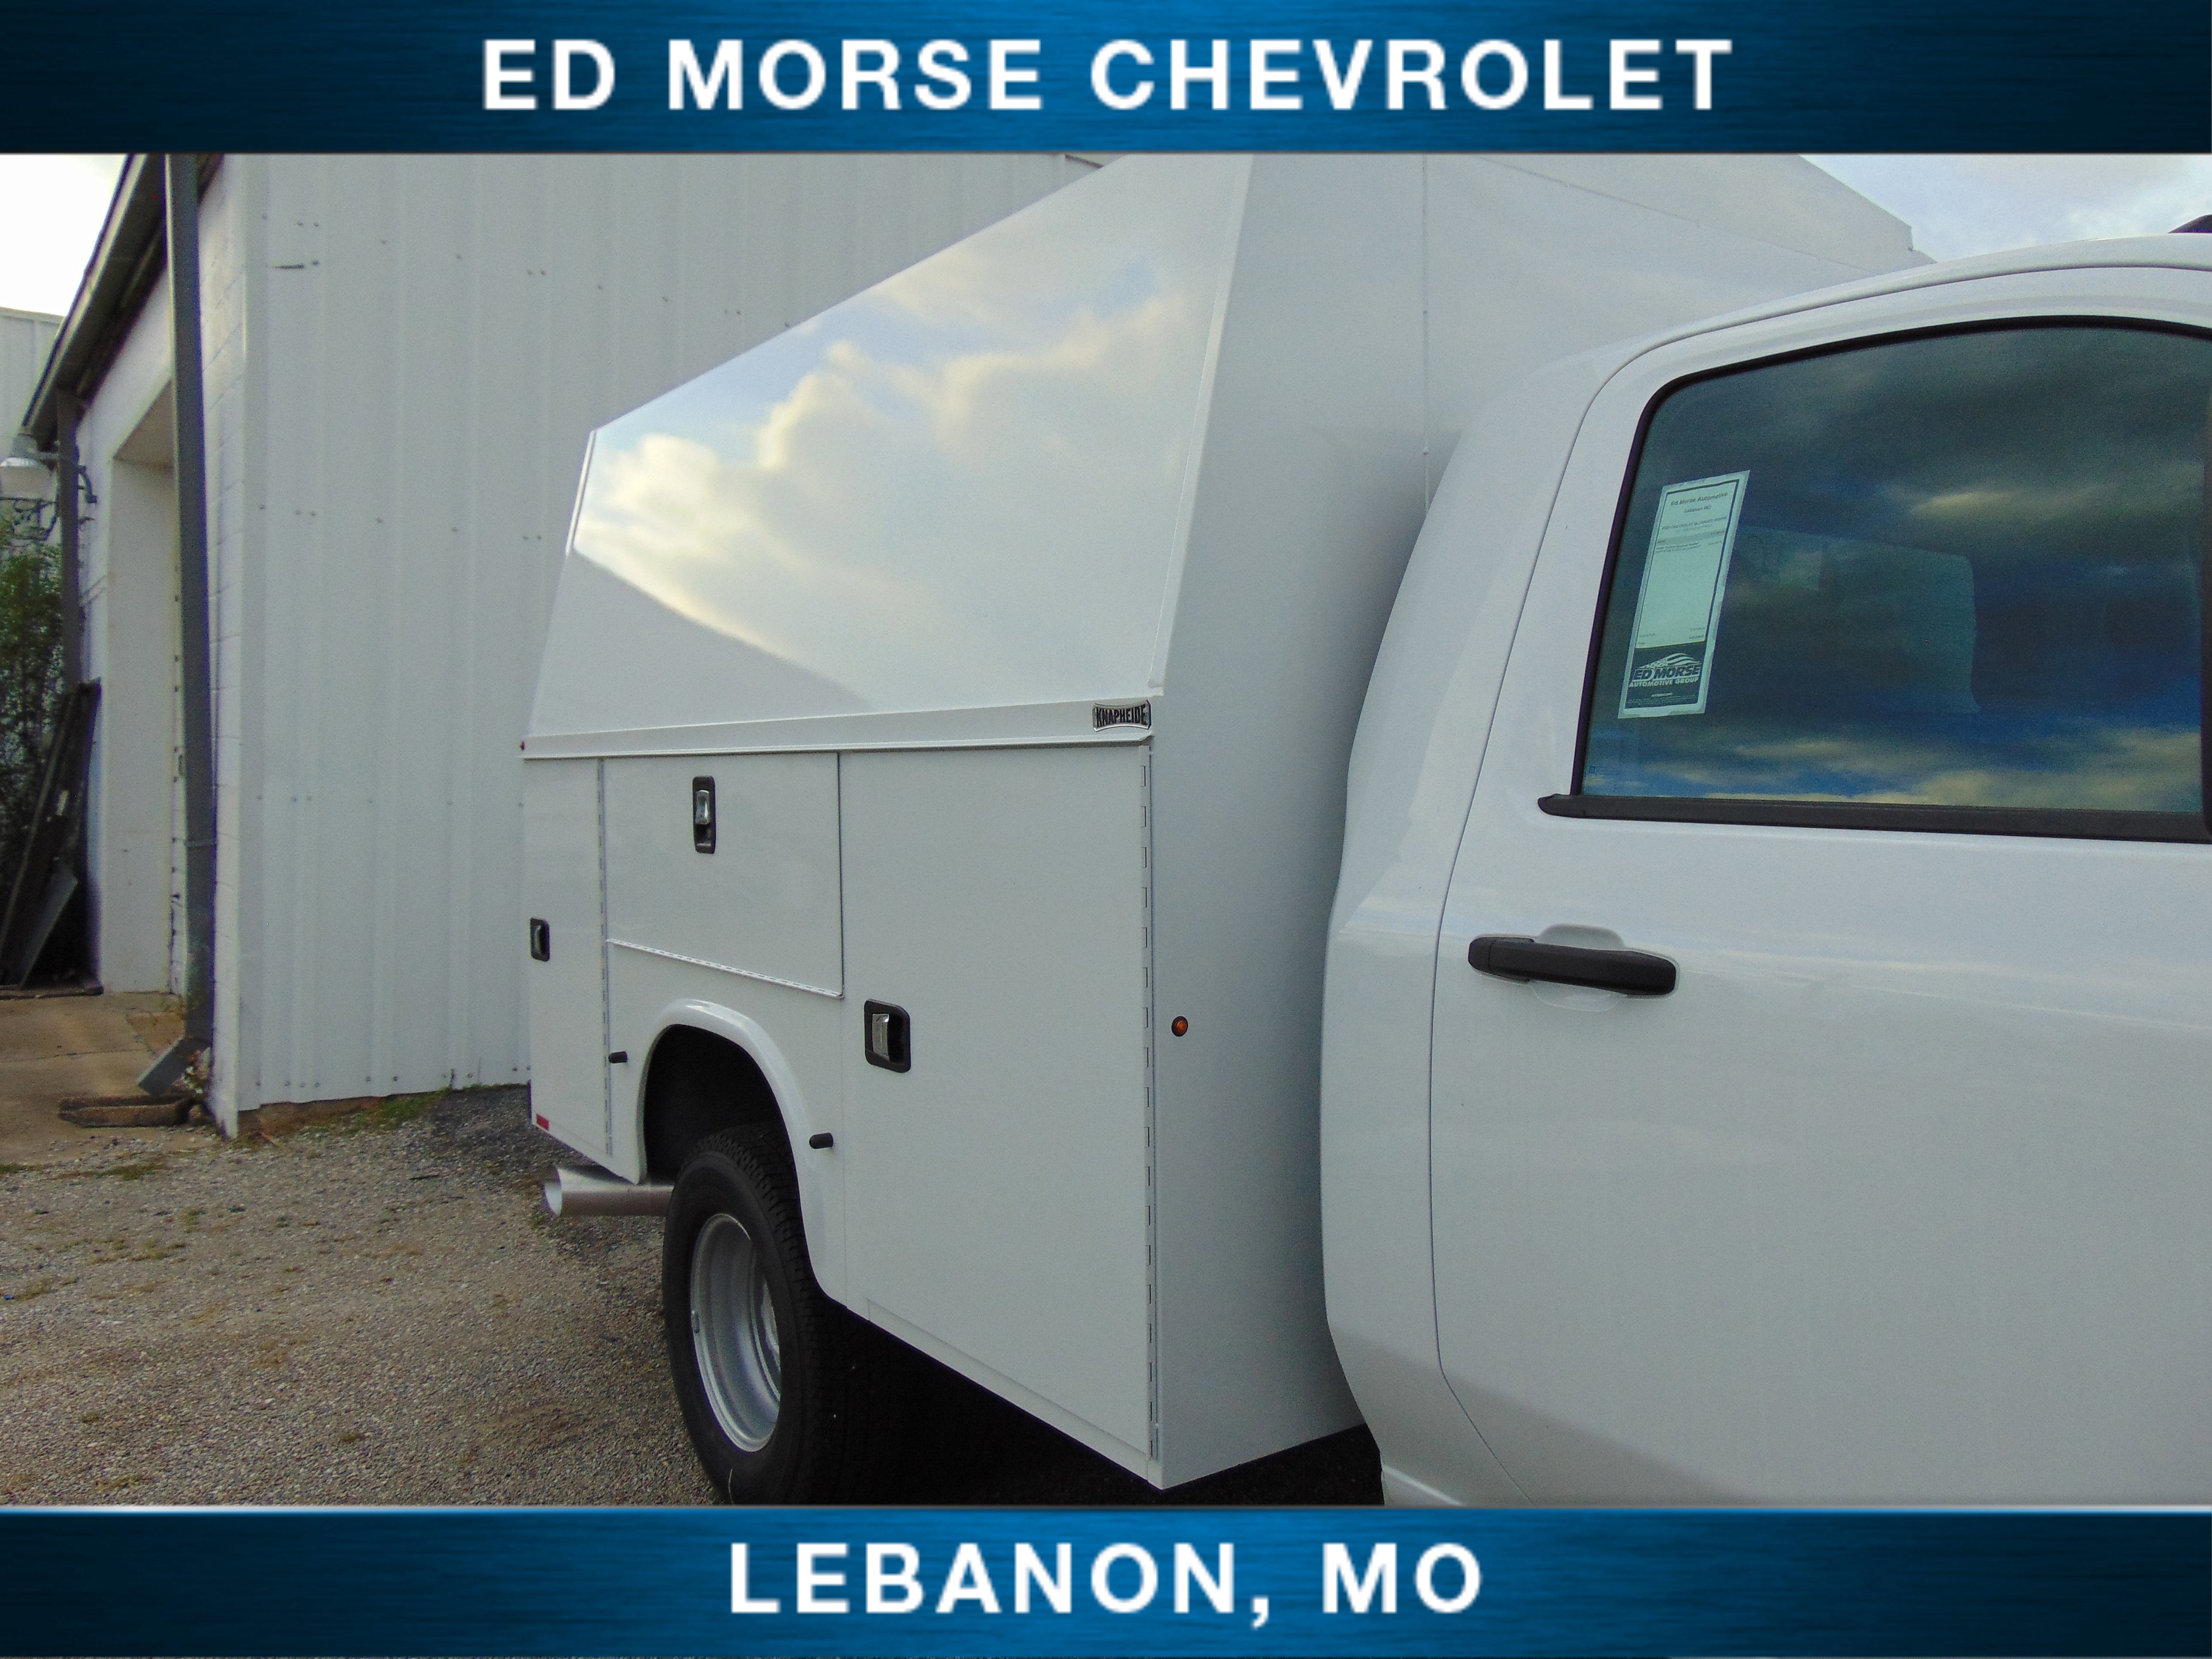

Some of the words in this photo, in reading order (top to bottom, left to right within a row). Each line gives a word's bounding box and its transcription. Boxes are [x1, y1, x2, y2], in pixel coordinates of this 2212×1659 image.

[1697, 492, 1728, 501] Automotive
[1634, 669, 1653, 680] ED
[1654, 665, 1701, 679] MORSE
[1096, 704, 1148, 728] KNAPHEIDE
